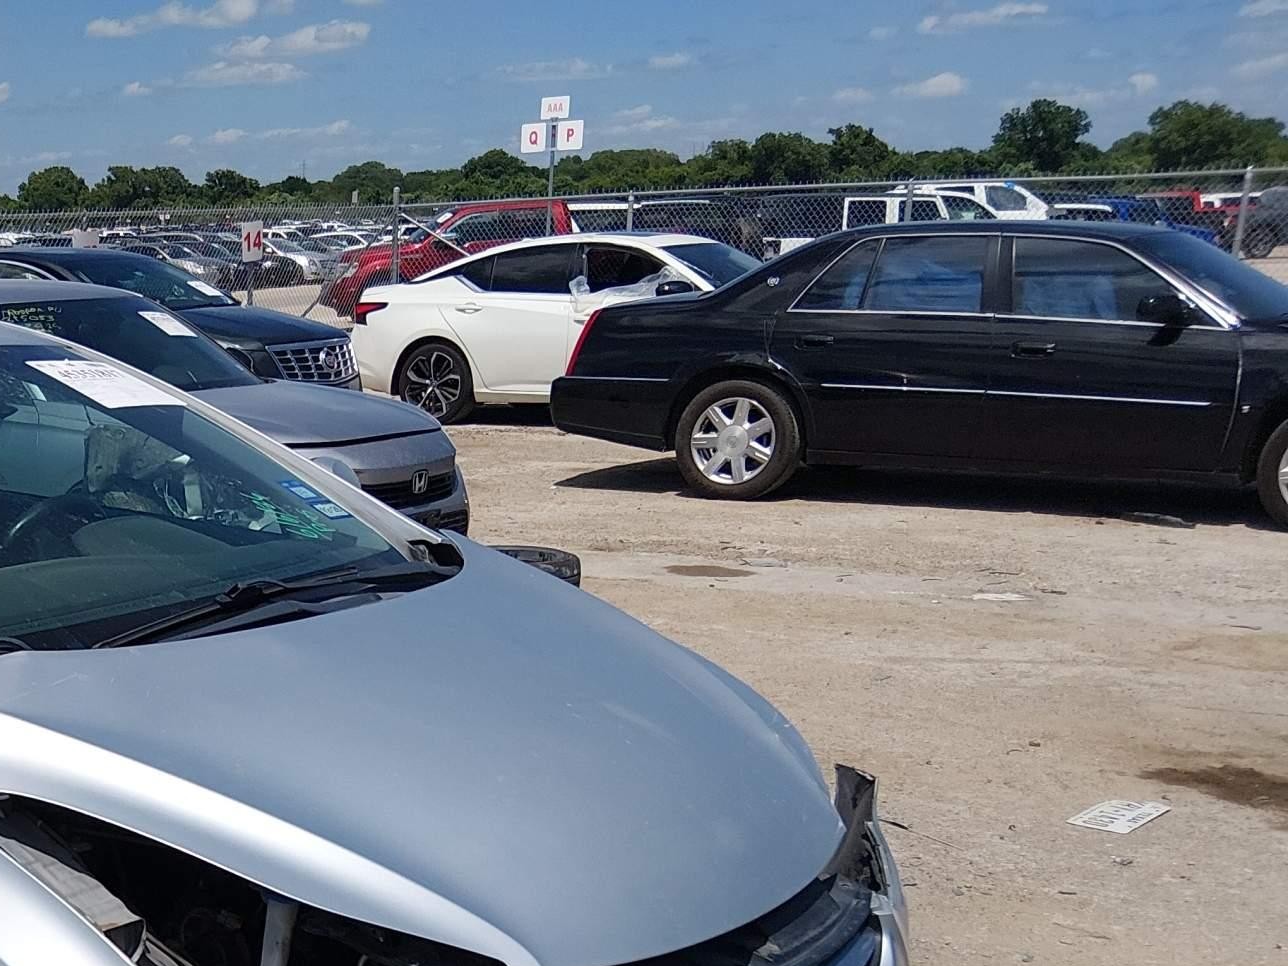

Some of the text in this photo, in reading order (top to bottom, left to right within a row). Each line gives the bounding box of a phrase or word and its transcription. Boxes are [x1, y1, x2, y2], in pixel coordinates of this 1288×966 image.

[547, 102, 564, 112] AAA
[529, 130, 538, 145] Q
[566, 128, 574, 142] P
[244, 230, 262, 252] 14
